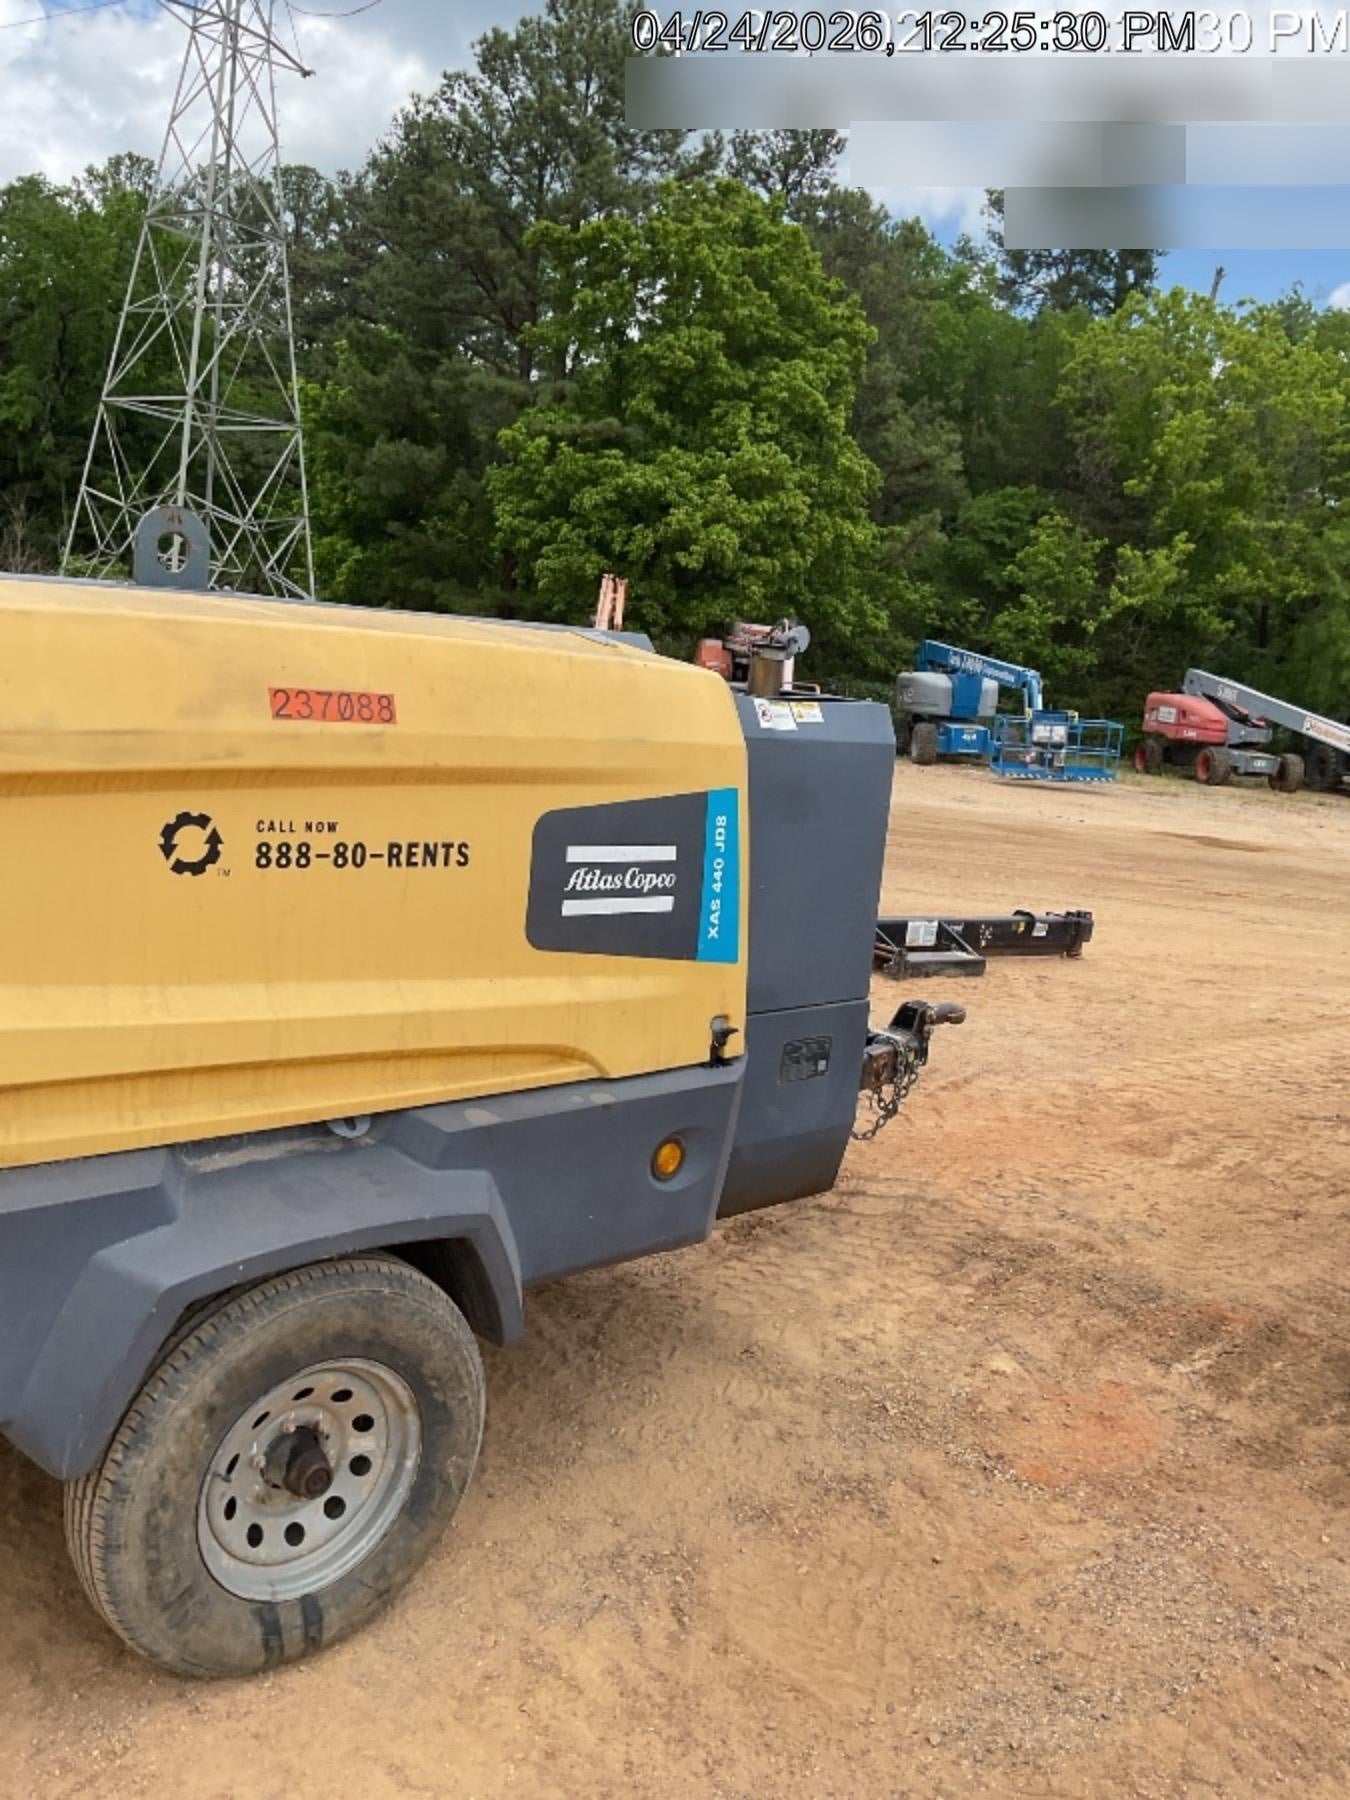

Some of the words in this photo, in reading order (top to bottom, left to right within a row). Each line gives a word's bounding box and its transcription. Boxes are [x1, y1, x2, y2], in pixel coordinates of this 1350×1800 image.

[272, 688, 394, 723] 237088
[256, 819, 296, 833] CALL
[305, 821, 339, 833] NOW
[255, 841, 470, 869] 888-80-RENTS
[564, 867, 623, 892] Atlas
[623, 867, 677, 892] Copco
[711, 858, 725, 893] 440
[707, 899, 721, 940] XAS
